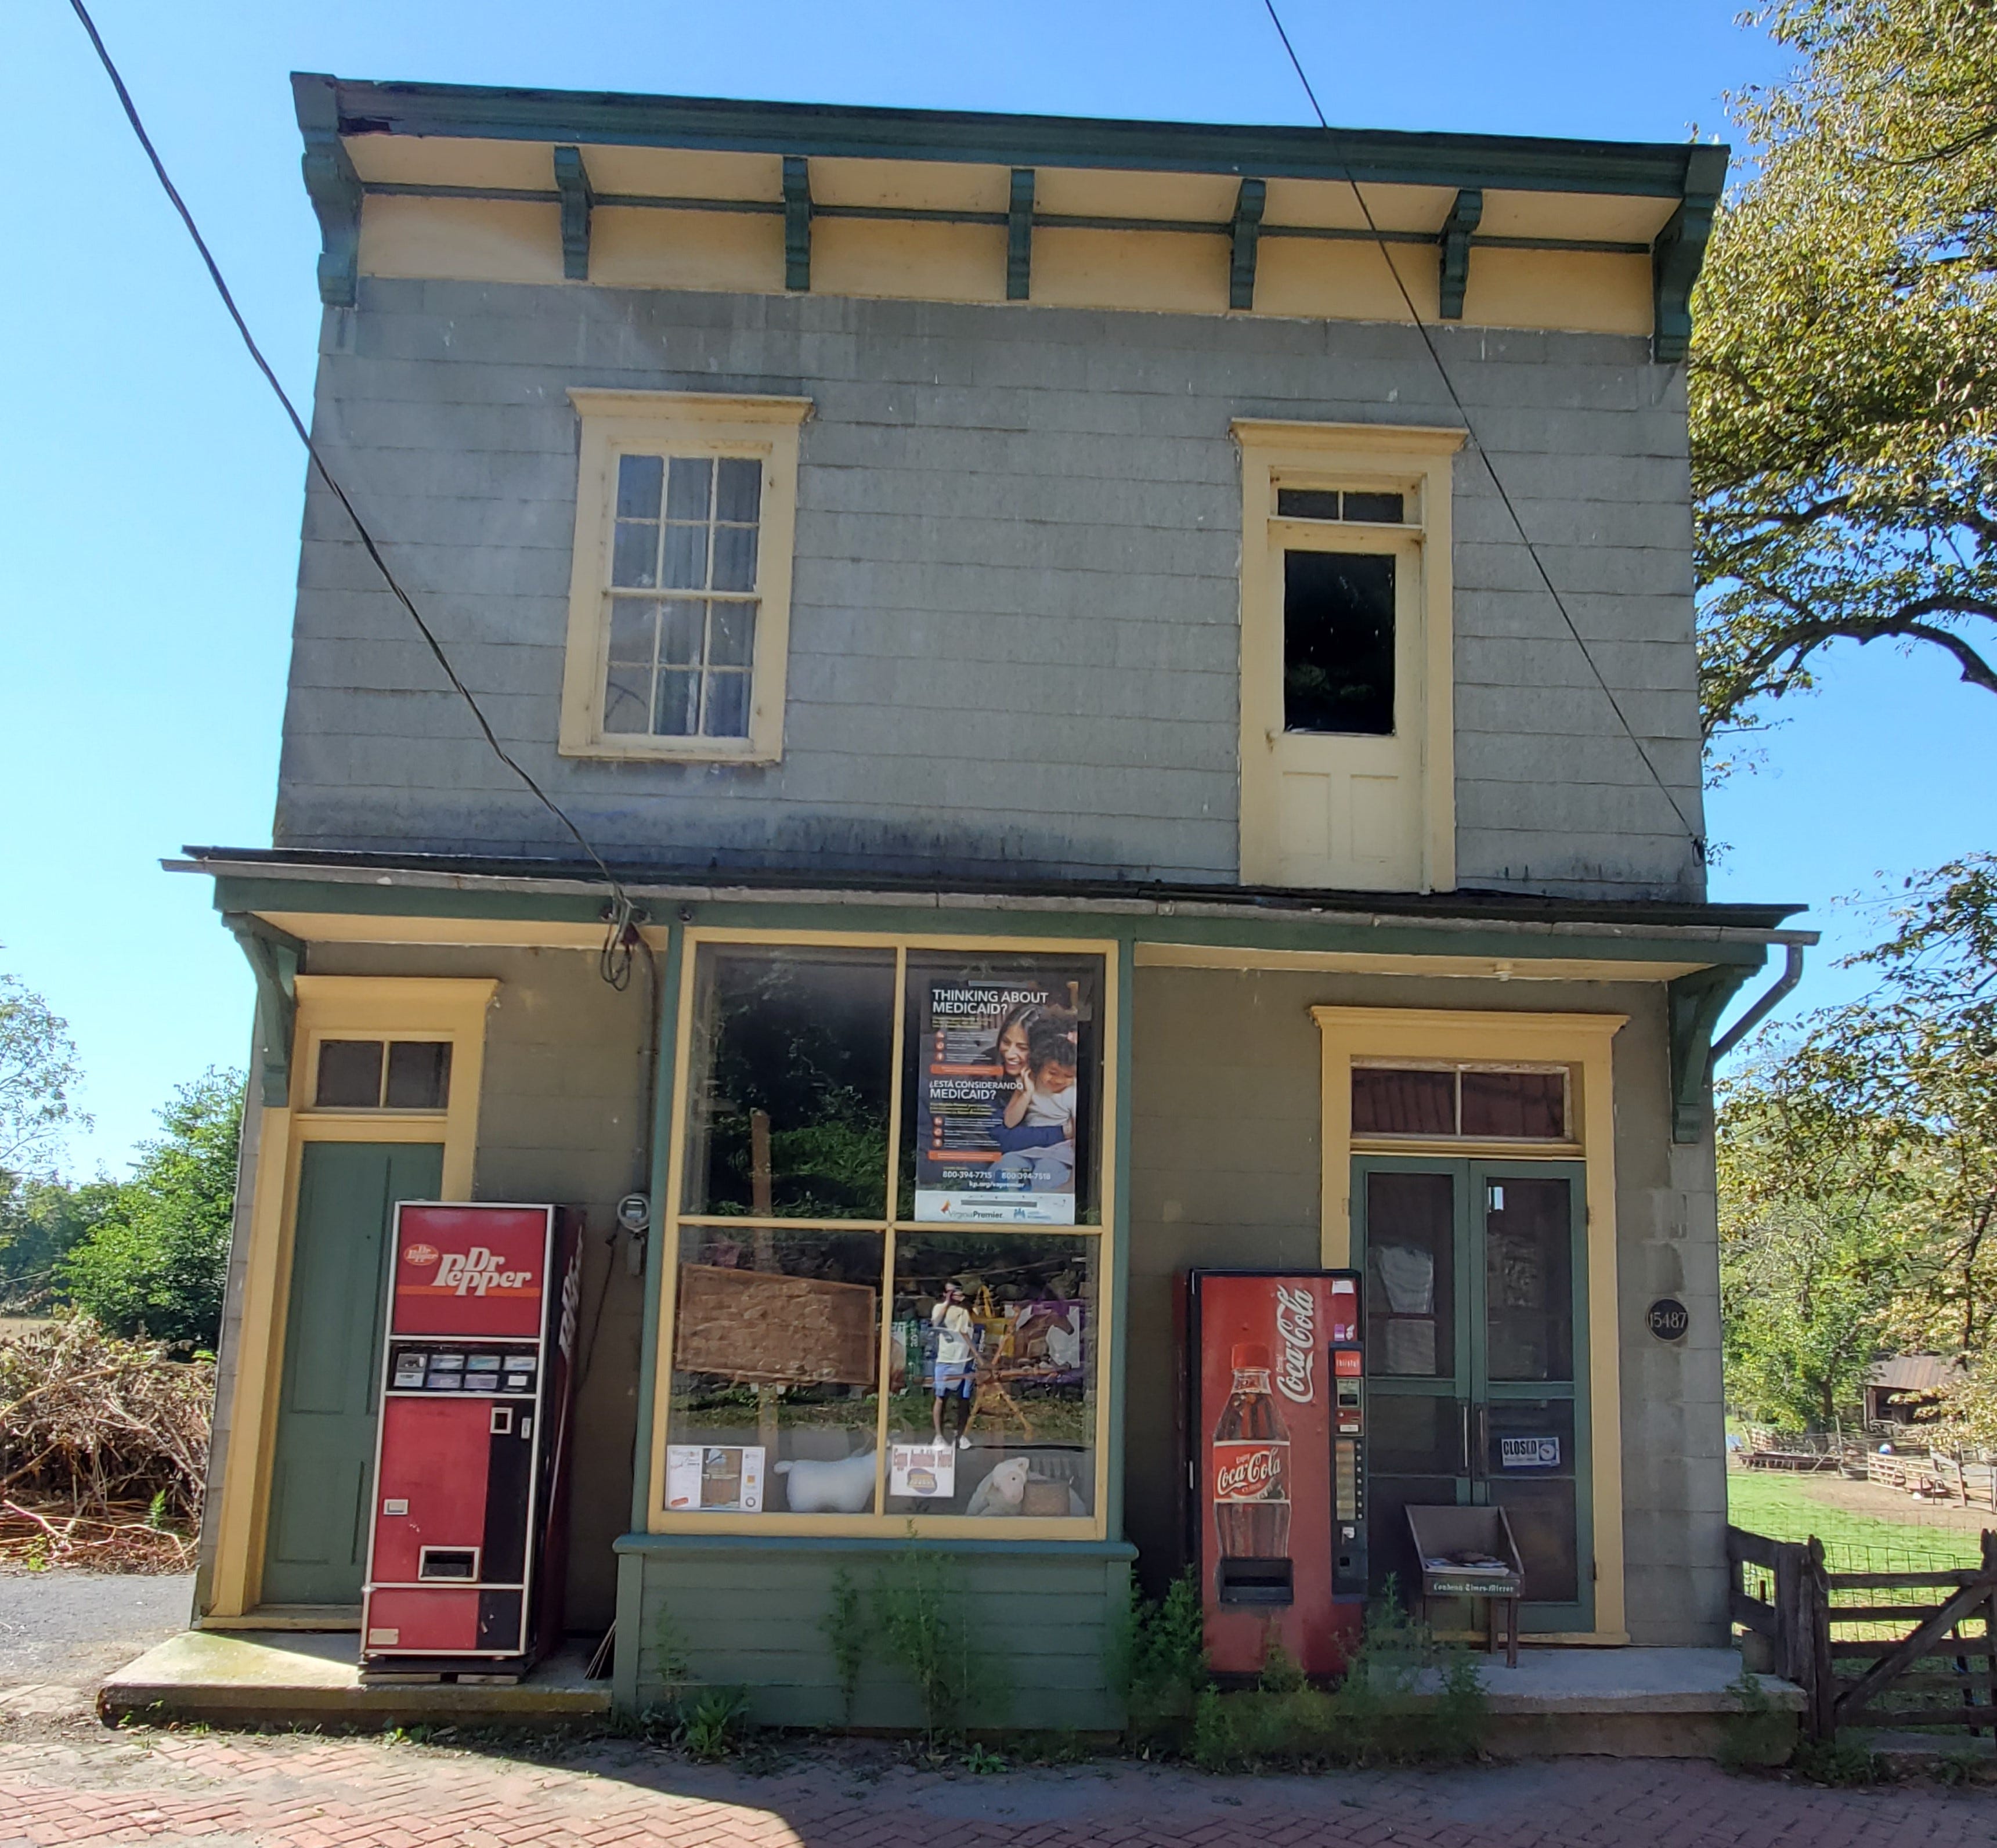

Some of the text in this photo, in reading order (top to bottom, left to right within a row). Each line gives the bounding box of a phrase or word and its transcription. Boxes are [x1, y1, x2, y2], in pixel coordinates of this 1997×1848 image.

[932, 989, 1049, 1004] THINKING ABOUT
[932, 1002, 1007, 1015] MEDICAID?
[929, 1079, 1024, 1090] ¿ESTÁ CONSIDERANDO
[930, 1088, 996, 1100] MEDICAID?
[463, 1247, 506, 1272] Dr
[431, 1254, 532, 1296] Pepper
[1649, 1312, 1687, 1328] 15487
[1276, 1284, 1314, 1403] Coca-Cola
[1503, 1441, 1537, 1455] CLOSED
[1217, 1447, 1281, 1495] Coca-Cola
